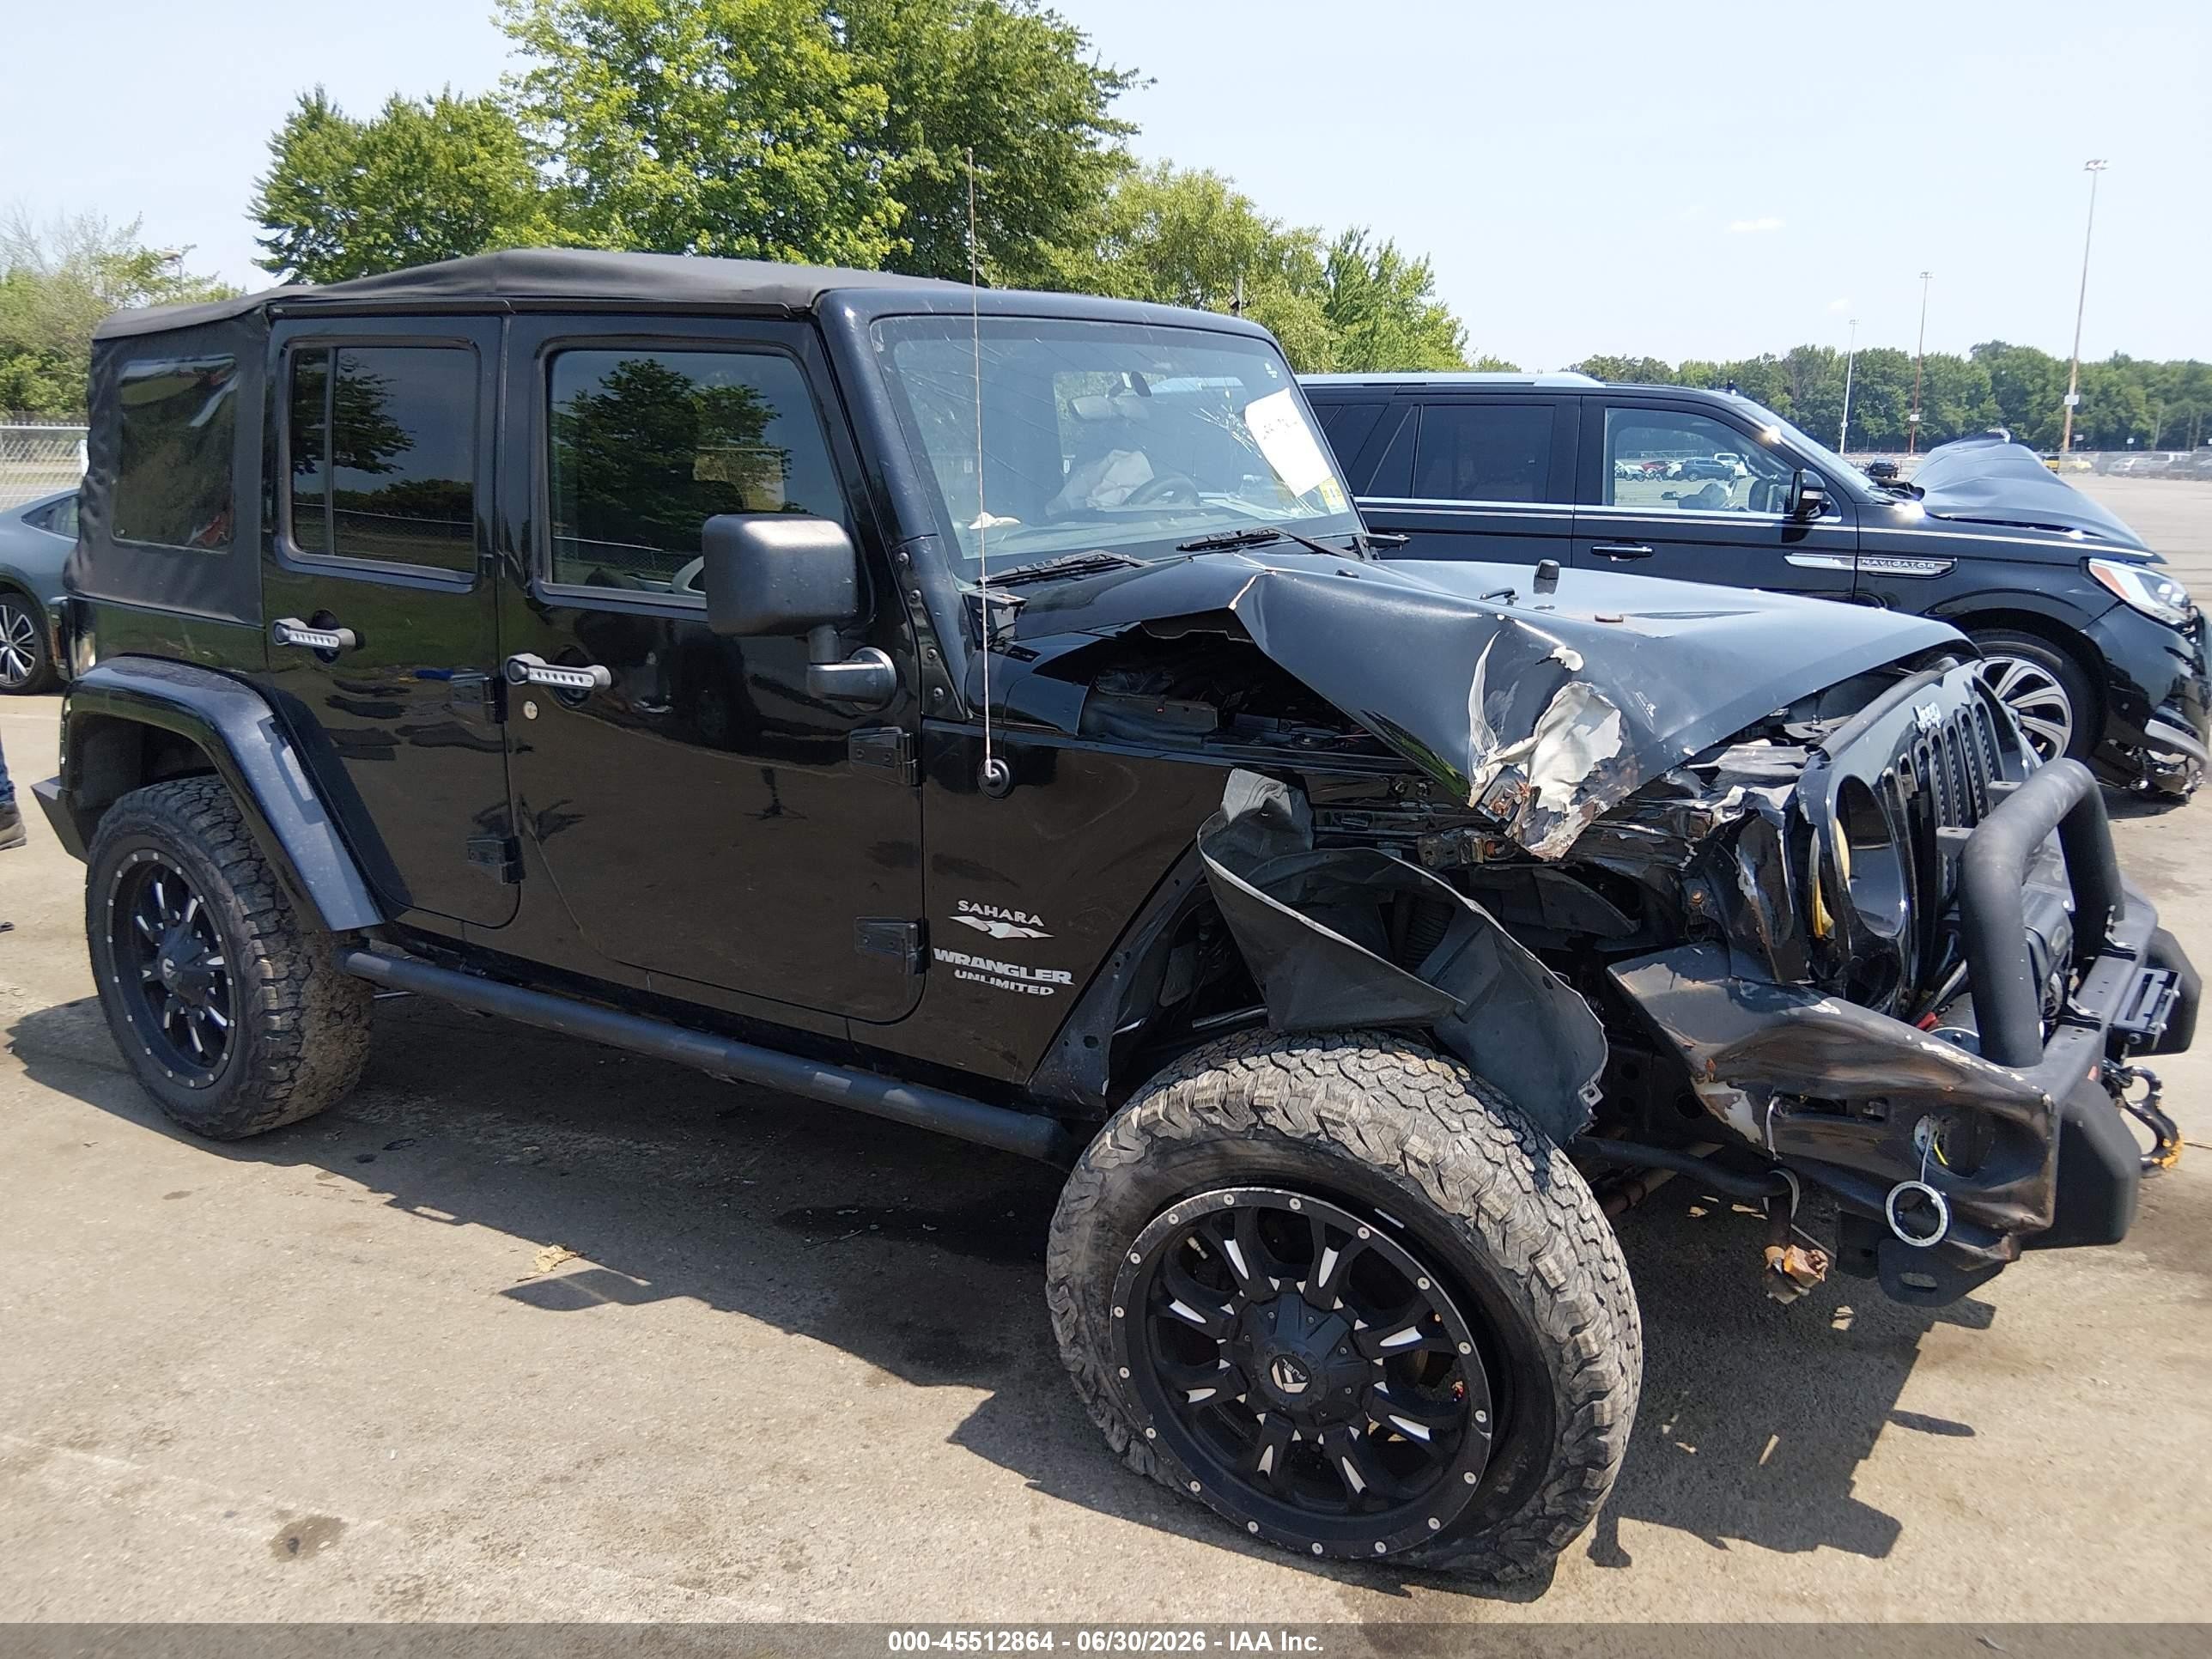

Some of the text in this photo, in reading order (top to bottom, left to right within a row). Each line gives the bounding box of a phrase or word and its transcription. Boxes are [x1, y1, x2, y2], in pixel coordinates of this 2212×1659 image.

[1861, 558, 1936, 570] NAVIGATOR
[1912, 702, 1942, 733] Jeep
[957, 899, 1045, 927] SAHARA
[933, 947, 1076, 986] WRANGLER
[953, 969, 1055, 996] UNLIMITED
